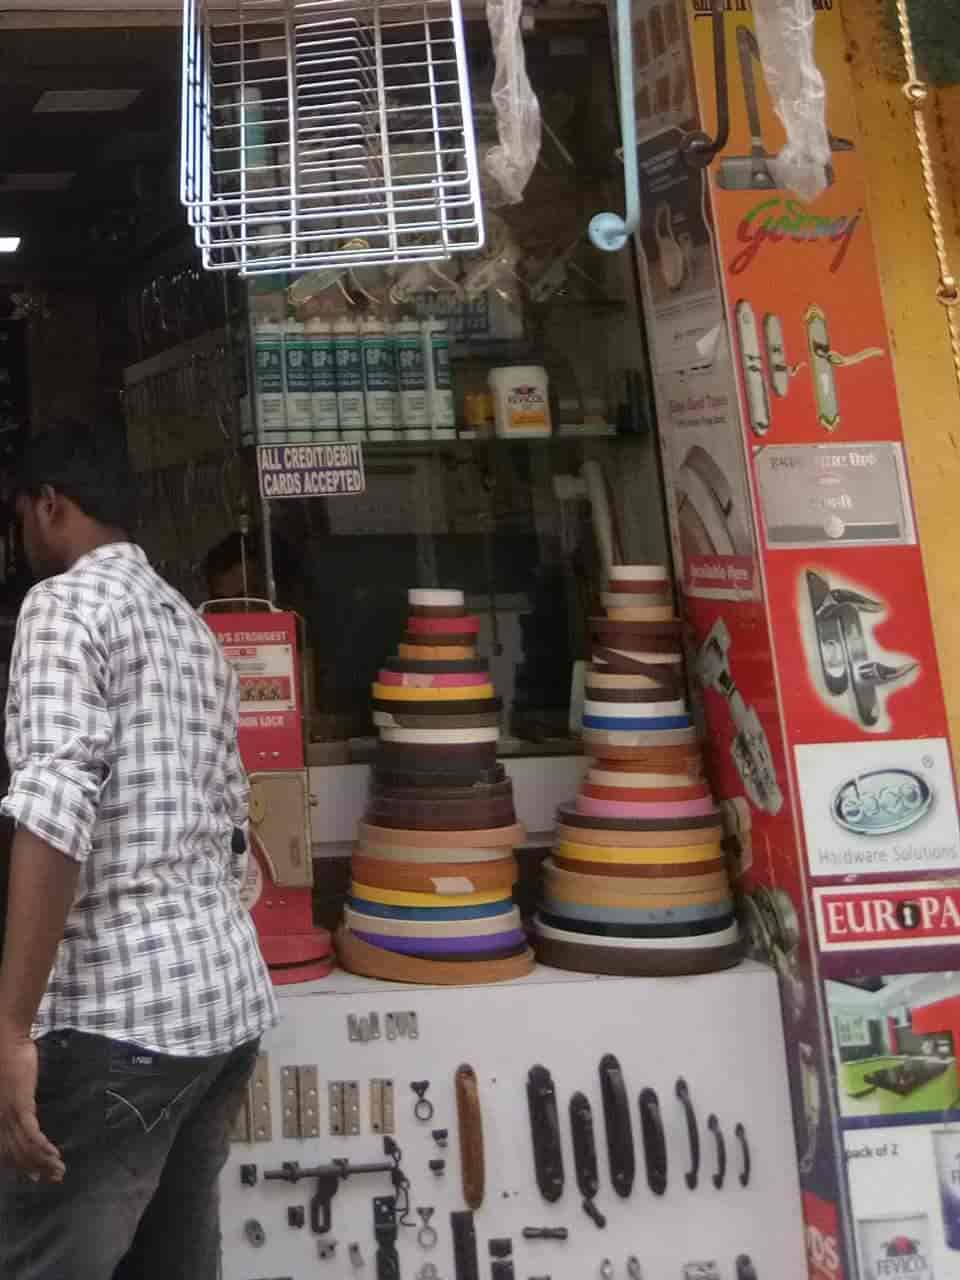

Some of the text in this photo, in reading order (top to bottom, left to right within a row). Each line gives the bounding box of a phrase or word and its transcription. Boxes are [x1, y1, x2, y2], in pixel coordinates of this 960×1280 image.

[262, 448, 283, 469] ALL
[263, 470, 361, 495] CARDS ACCEPTED
[827, 896, 960, 934] EUROPA
